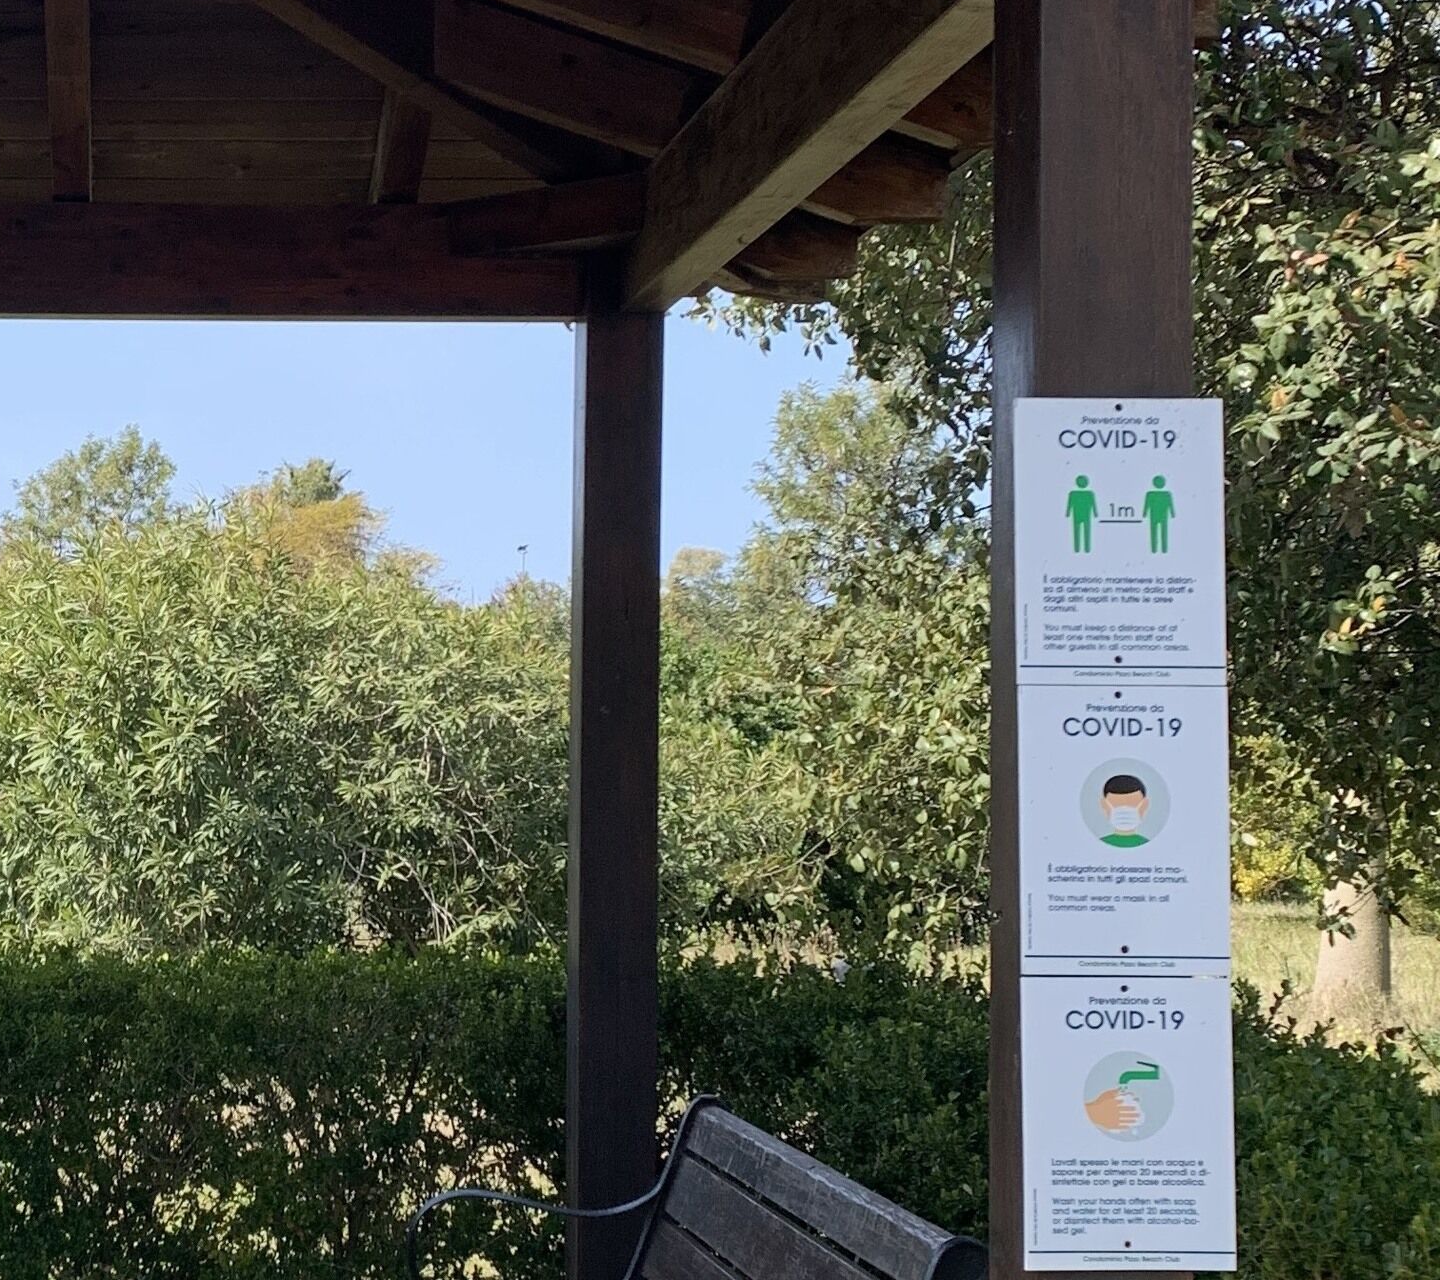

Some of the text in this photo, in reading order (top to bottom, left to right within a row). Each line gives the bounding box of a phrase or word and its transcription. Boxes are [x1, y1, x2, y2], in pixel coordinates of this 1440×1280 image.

[1080, 415, 1160, 425] Prevenzione da
[1058, 429, 1177, 449] COVID-19
[1109, 503, 1136, 518] 1m
[1086, 704, 1164, 712] Prevenzione da
[1063, 717, 1182, 737] COVID-19
[1048, 894, 1065, 902] You
[1066, 894, 1088, 902] must
[1122, 894, 1145, 902] mask
[1148, 894, 1157, 902] in
[1159, 894, 1170, 902] all
[1089, 996, 1167, 1005] Prevenzione da
[1065, 1010, 1185, 1030] COVID-19
[1051, 1158, 1077, 1166] Lavati
[1079, 1159, 1109, 1167] spesso
[1111, 1158, 1119, 1166] le
[1121, 1158, 1144, 1166] mani
[1165, 1159, 1196, 1167] acqua
[1051, 1169, 1084, 1177] sapone
[1086, 1169, 1101, 1177] per
[1103, 1168, 1138, 1176] almeno
[1139, 1168, 1151, 1176] 20
[1152, 1168, 1188, 1176] secondi
[1198, 1168, 1211, 1176] di-
[1052, 1198, 1196, 1207] Wash your hands often with soap
[1052, 1207, 1070, 1215] and
[1072, 1207, 1097, 1215] water
[1098, 1207, 1111, 1215] for
[1112, 1207, 1122, 1215] at
[1123, 1207, 1145, 1215] least
[1146, 1207, 1157, 1215] 20
[1064, 1217, 1100, 1225] disinfect
[1101, 1217, 1125, 1225] them
[1127, 1217, 1146, 1225] with
[1052, 1226, 1087, 1236] sed gel.
